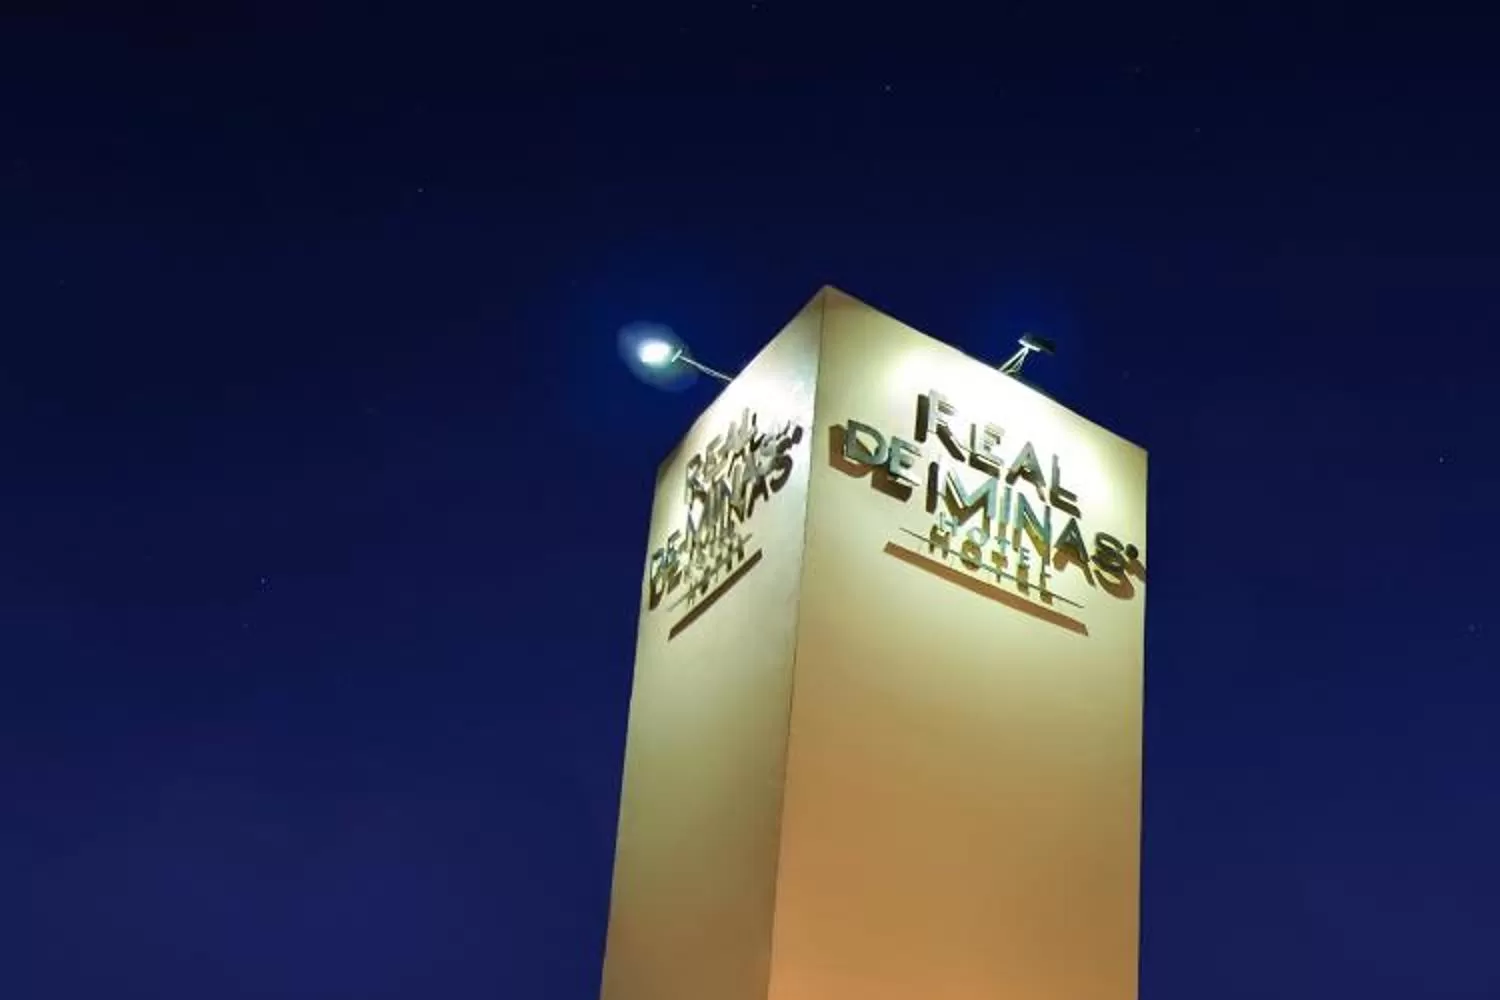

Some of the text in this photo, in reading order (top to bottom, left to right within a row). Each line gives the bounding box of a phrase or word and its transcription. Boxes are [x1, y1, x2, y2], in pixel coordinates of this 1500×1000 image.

[834, 418, 1130, 592] DE MINAS
[916, 388, 1081, 518] REAL
